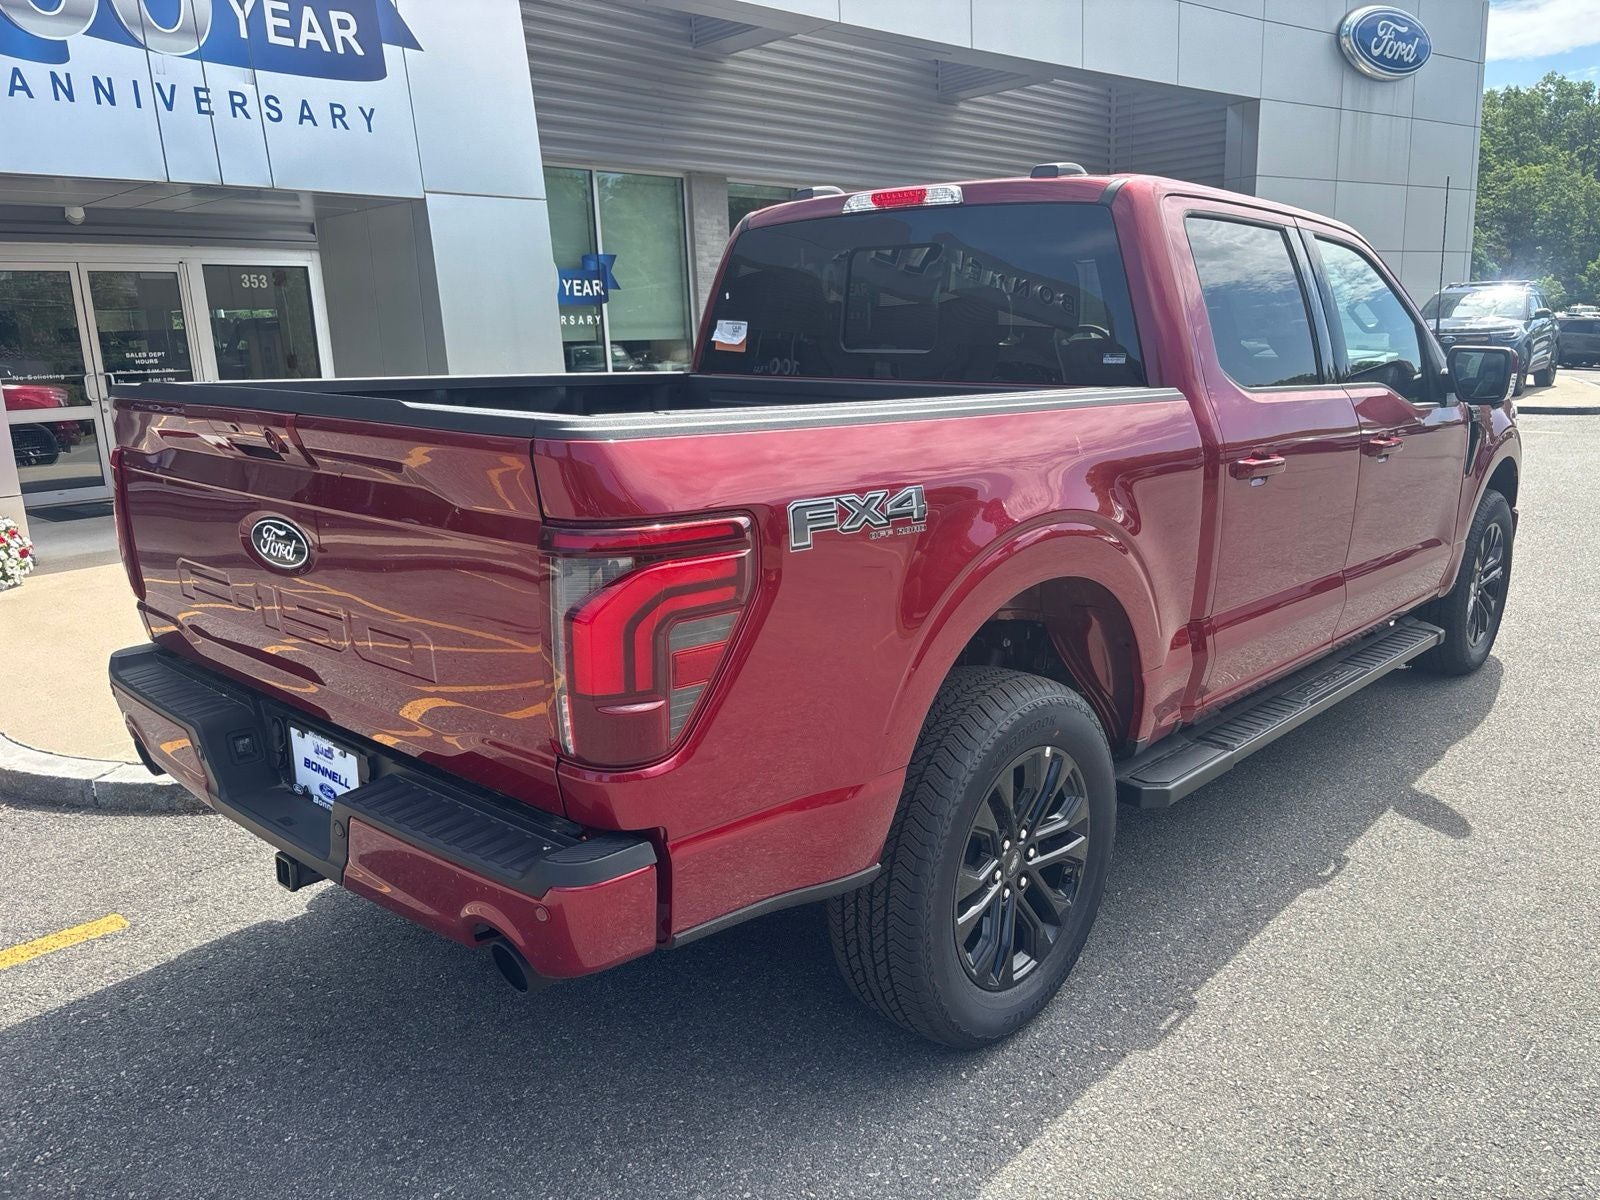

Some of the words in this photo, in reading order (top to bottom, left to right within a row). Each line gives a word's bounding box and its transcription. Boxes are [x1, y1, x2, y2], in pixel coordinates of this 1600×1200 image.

[224, 0, 366, 57] YEAR
[1371, 20, 1419, 63] Ford
[8, 67, 376, 133] ANNIVERSARY
[241, 273, 268, 288] 353
[562, 279, 605, 296] YEAR
[787, 485, 928, 552] FX4
[260, 524, 298, 561] Ford
[303, 756, 351, 790] BONNELL
